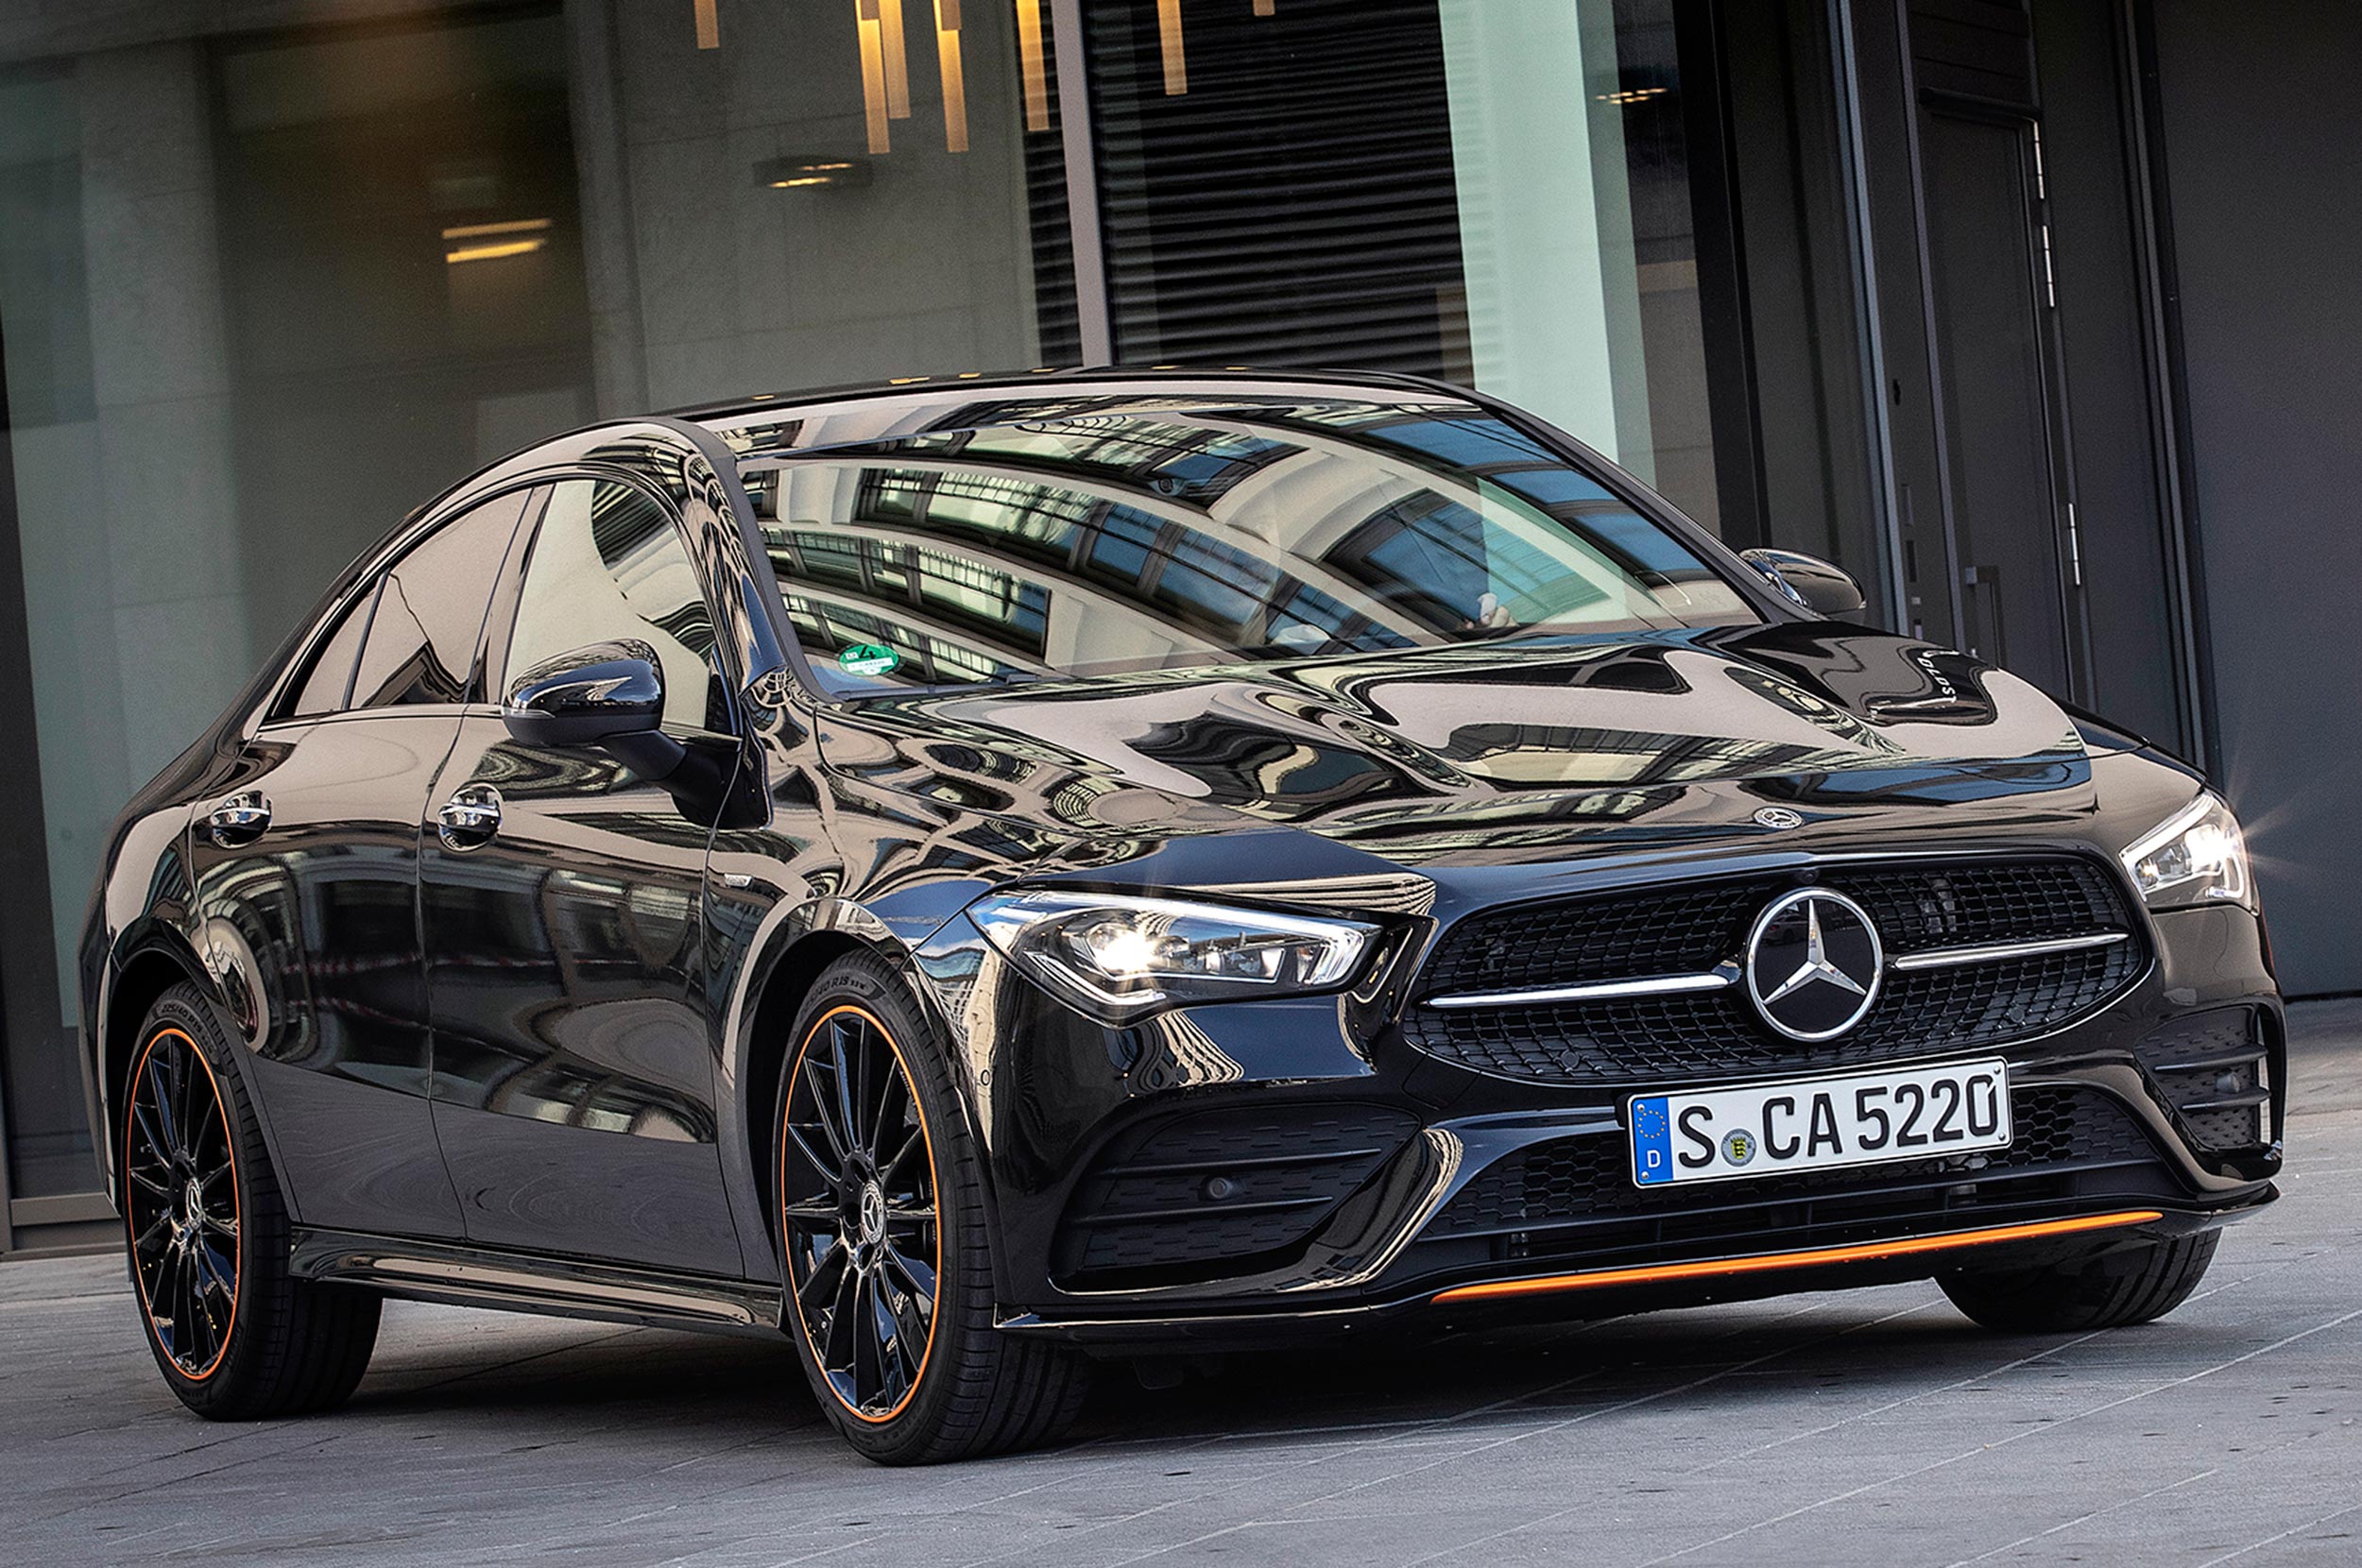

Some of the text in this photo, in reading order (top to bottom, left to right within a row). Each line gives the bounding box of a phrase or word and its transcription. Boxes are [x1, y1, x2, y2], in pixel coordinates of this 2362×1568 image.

[859, 645, 876, 659] 4
[1678, 1105, 1716, 1167] S
[1762, 1093, 1843, 1160] CA
[1856, 1074, 1998, 1150] 5220
[1647, 1150, 1661, 1168] D
